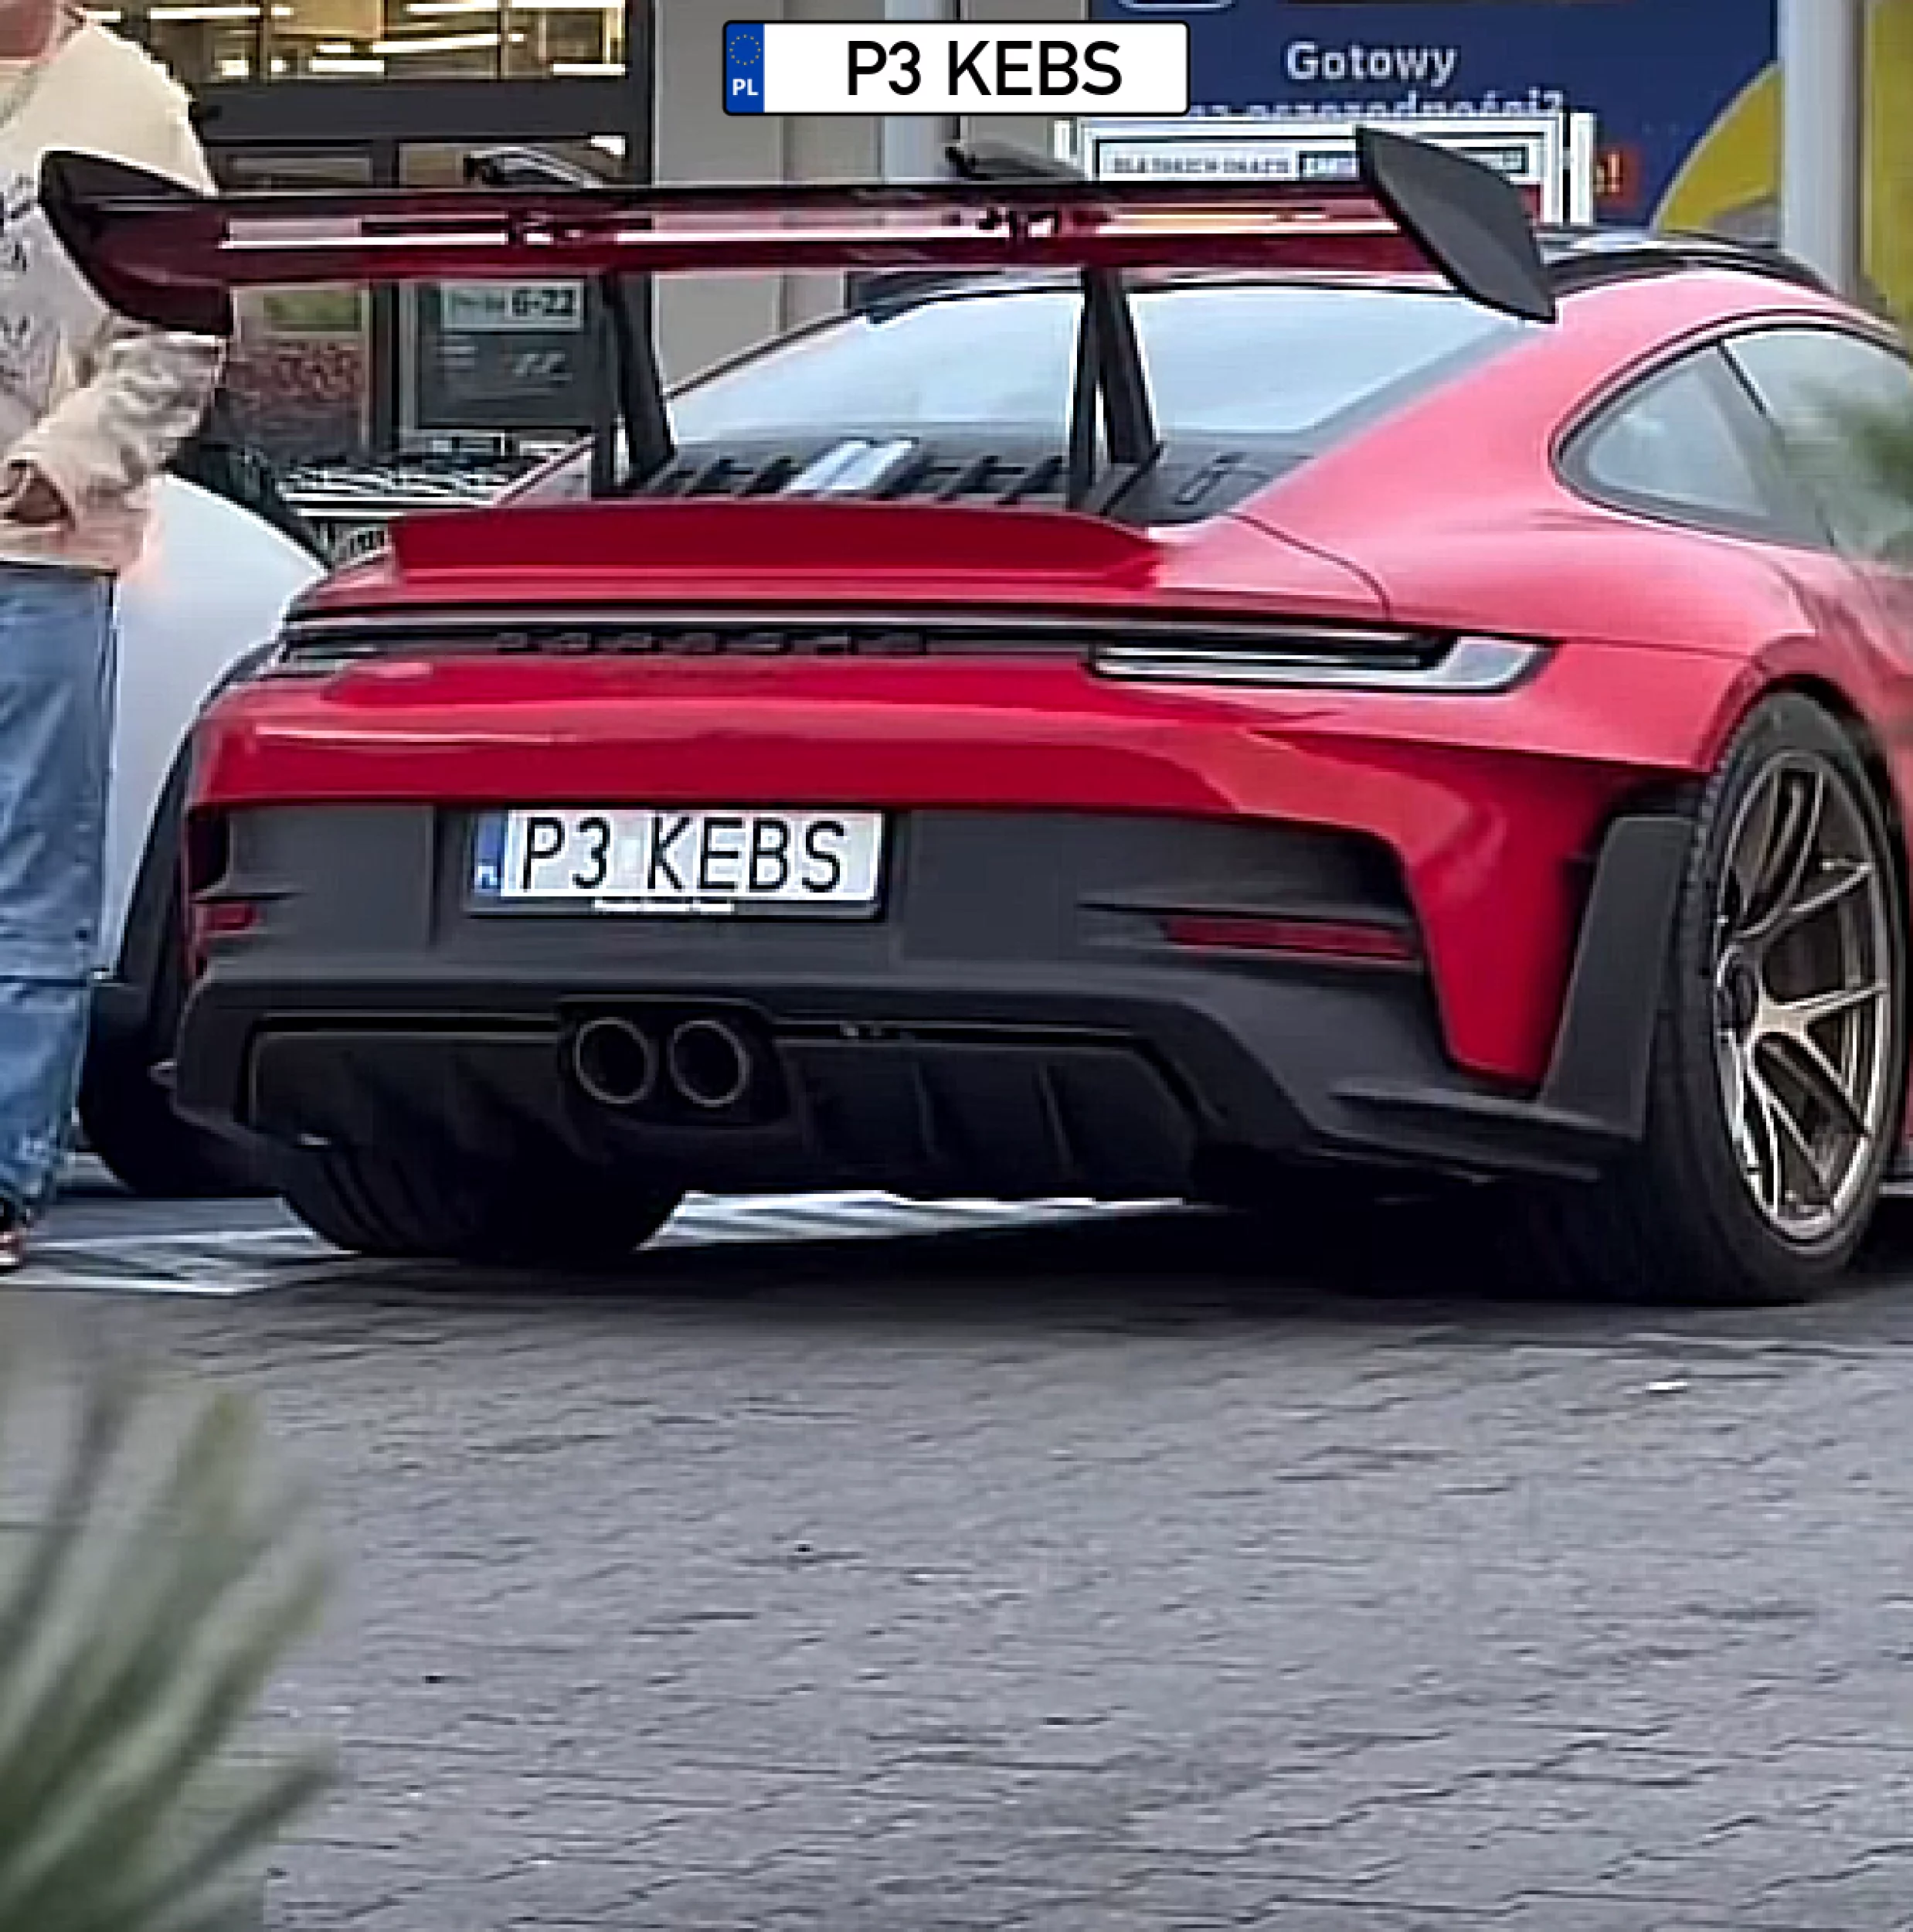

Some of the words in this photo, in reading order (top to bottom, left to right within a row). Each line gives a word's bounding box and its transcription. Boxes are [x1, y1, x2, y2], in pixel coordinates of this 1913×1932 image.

[1286, 42, 1457, 87] Gotowy
[521, 816, 611, 892] P3
[647, 816, 845, 893] KEBS
